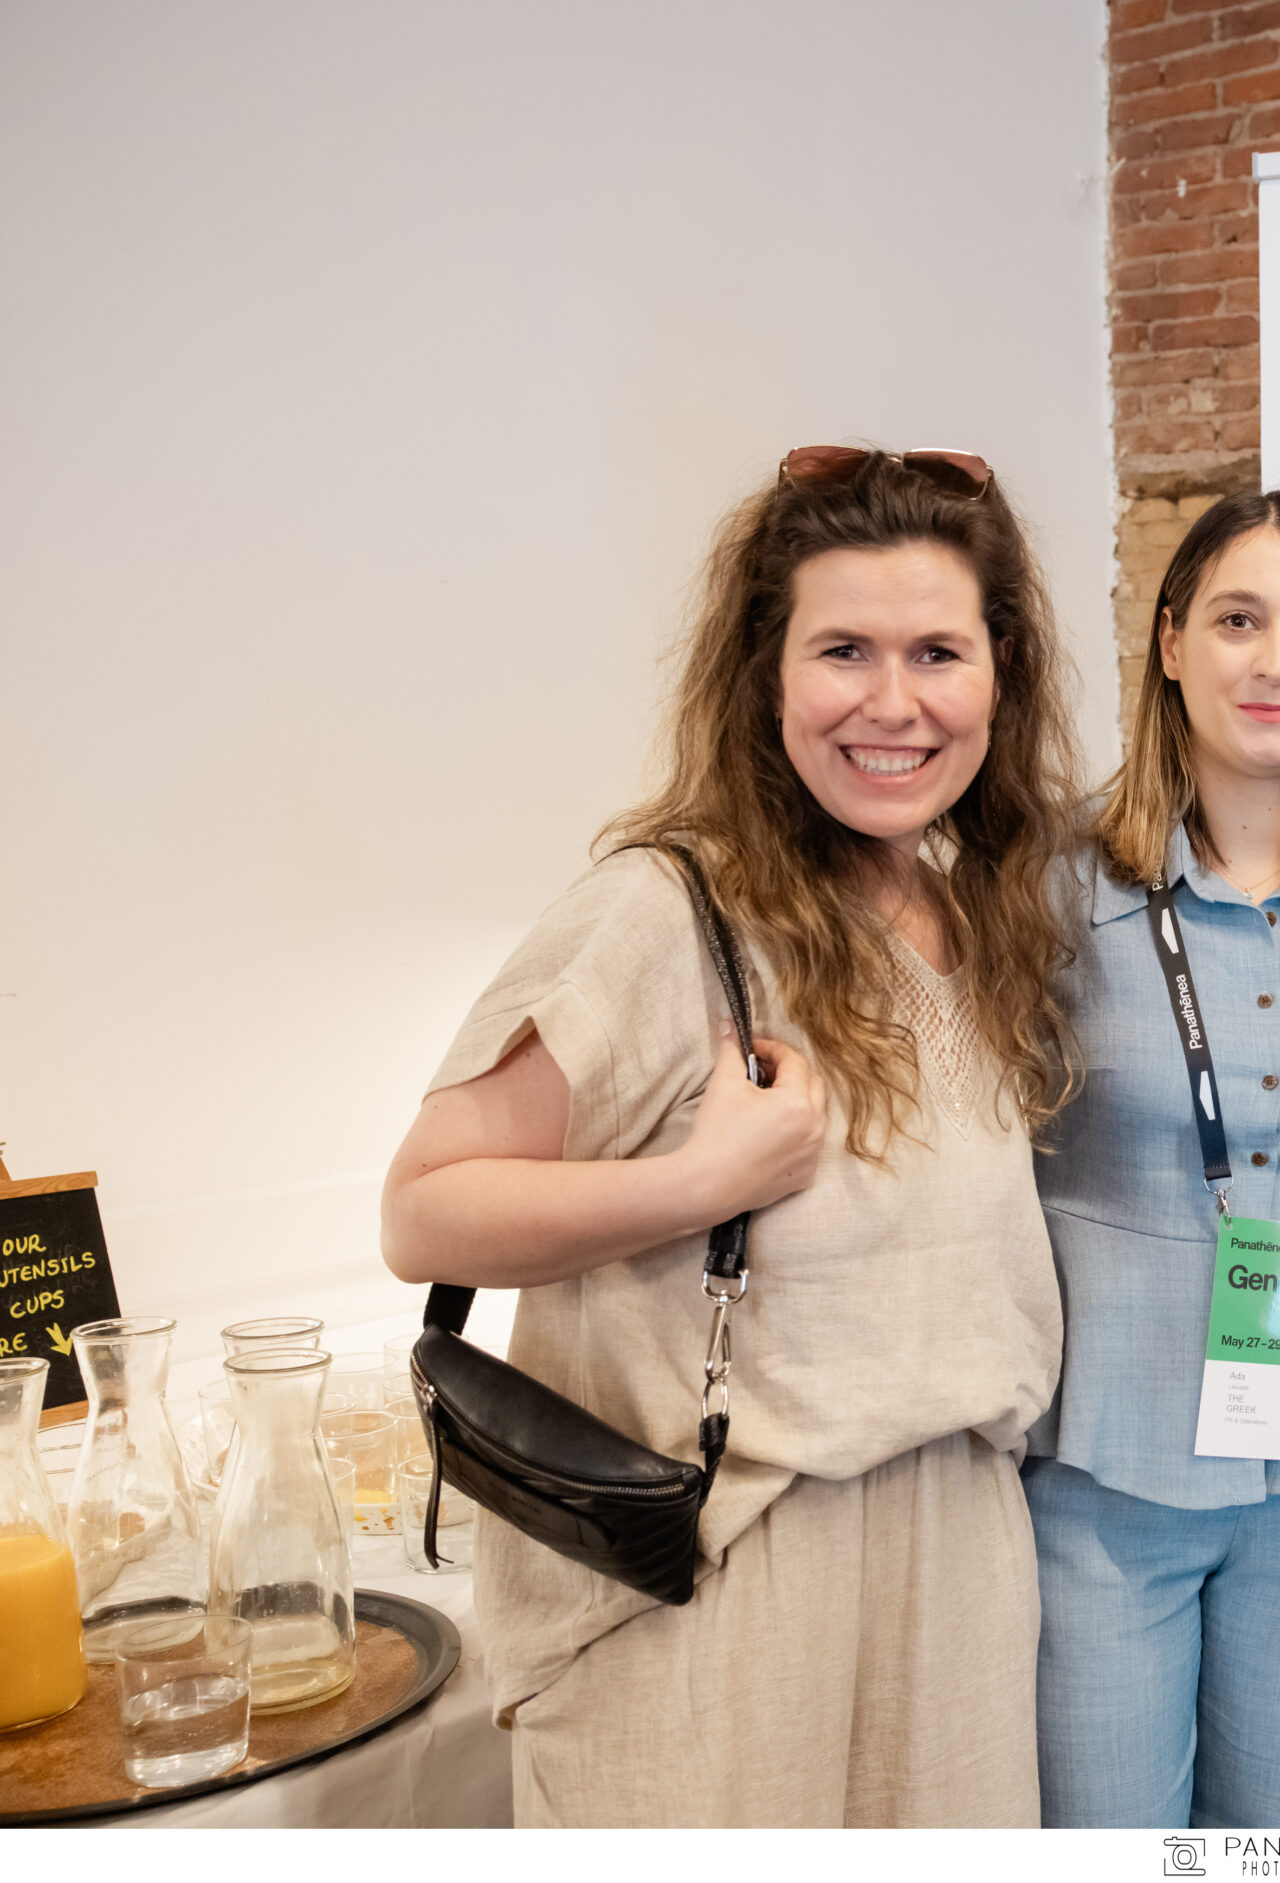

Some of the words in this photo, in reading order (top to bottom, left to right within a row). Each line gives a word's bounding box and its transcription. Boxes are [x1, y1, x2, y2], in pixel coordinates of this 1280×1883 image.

[10, 1290, 65, 1319] CUPS
[1221, 1335, 1244, 1350] May
[1230, 1372, 1246, 1381] Ada
[1228, 1394, 1245, 1404] THE
[1226, 1405, 1256, 1414] GREEK
